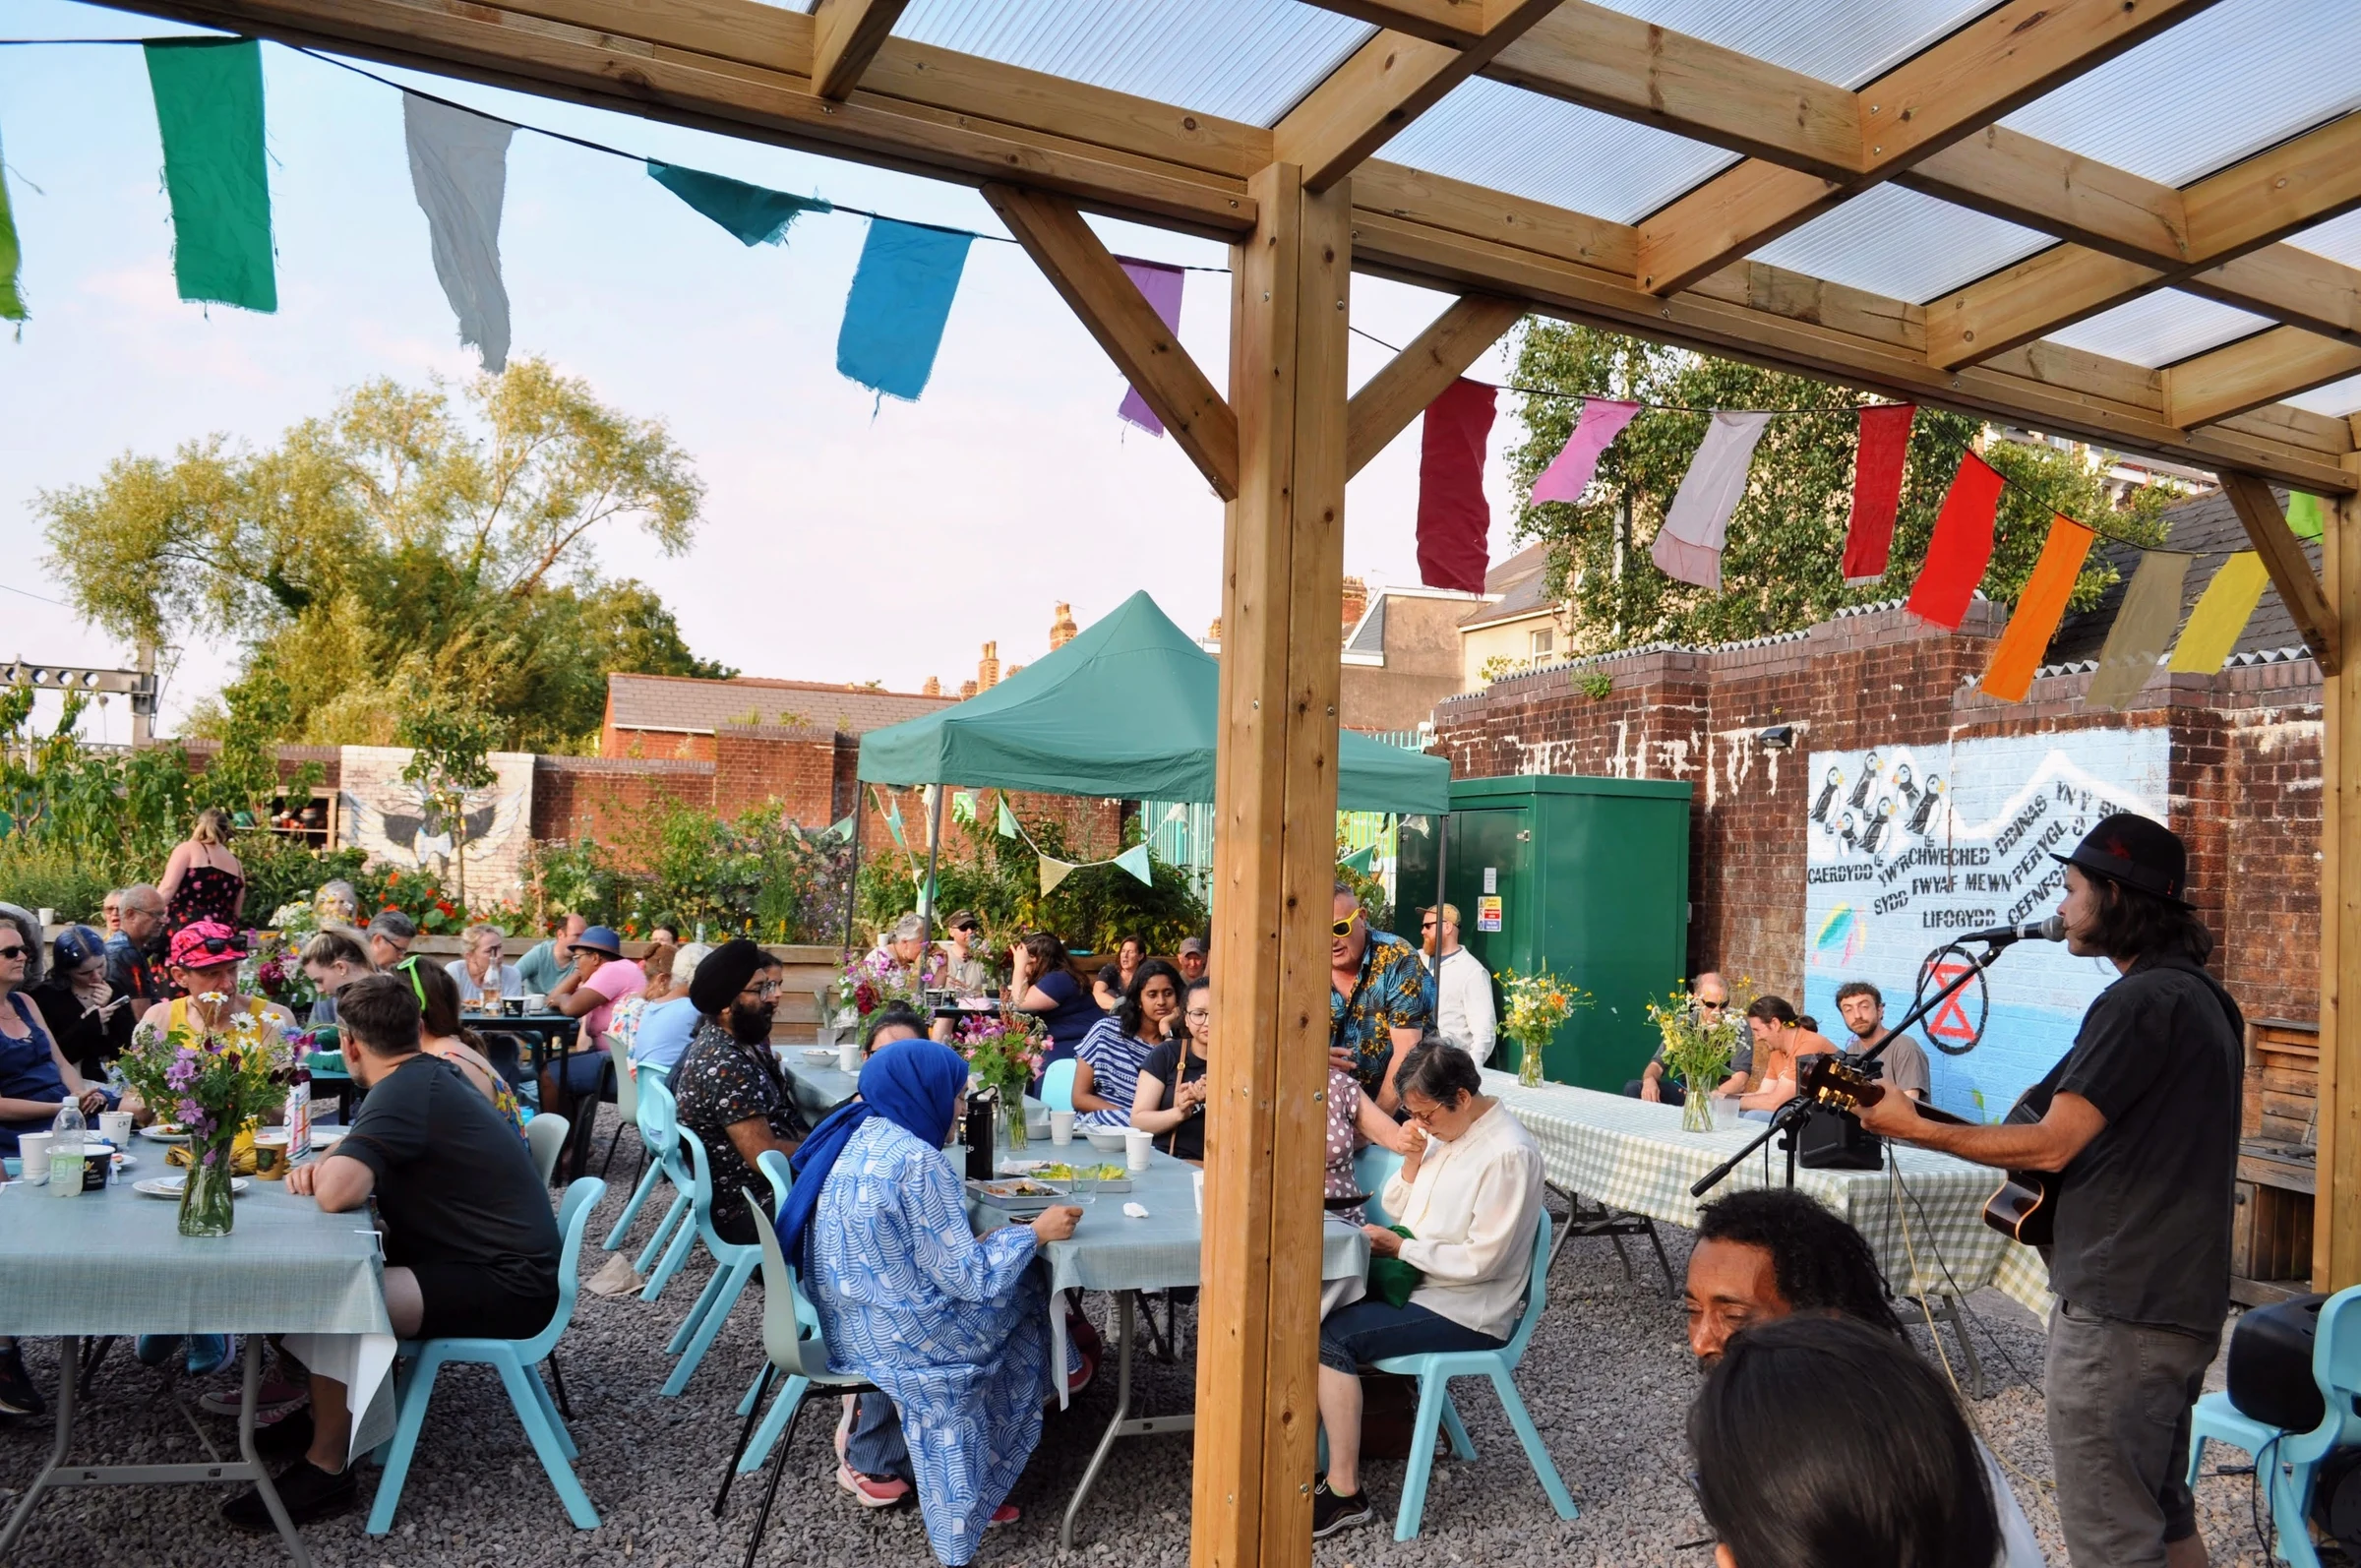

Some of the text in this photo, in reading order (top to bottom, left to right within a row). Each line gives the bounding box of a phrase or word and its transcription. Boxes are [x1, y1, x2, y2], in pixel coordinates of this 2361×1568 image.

[1807, 864, 1873, 884] CAERDYDD
[1908, 847, 1990, 868] CHWECHED
[1994, 794, 2047, 857] DDINAS
[1874, 889, 1908, 915] SYDD
[1965, 874, 2012, 892] MEWN
[2012, 820, 2068, 885] PERYGL
[1922, 908, 1996, 929] LIFOGYDD
